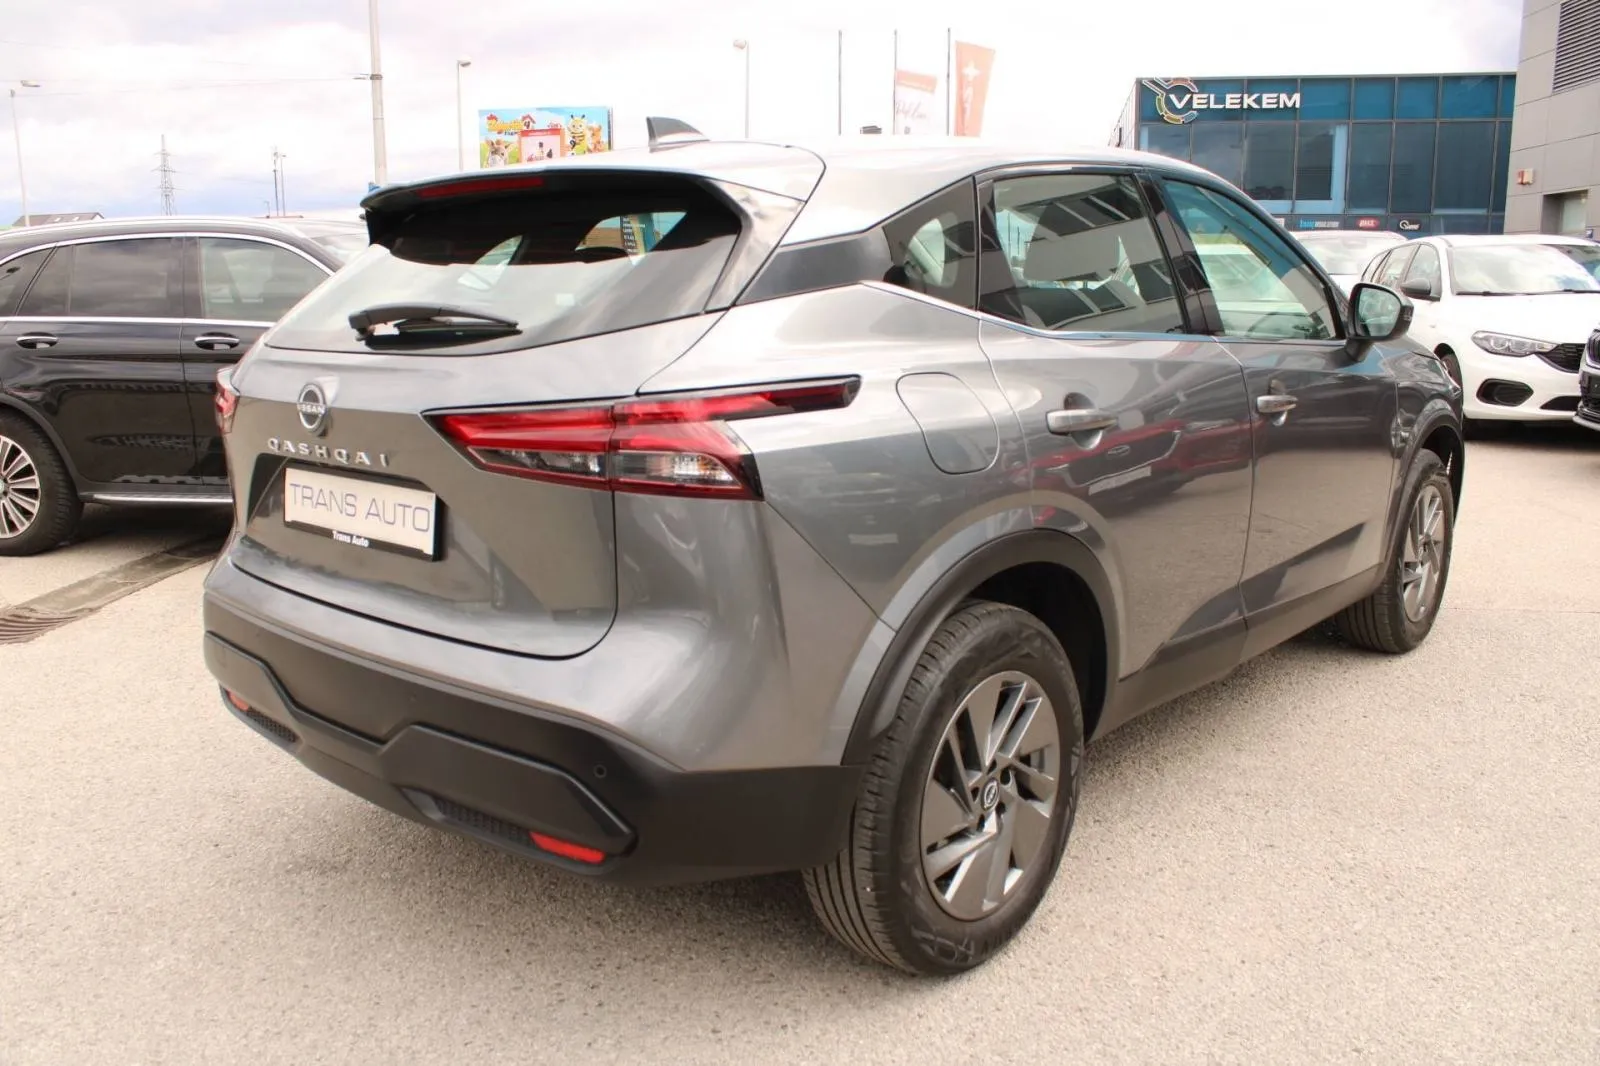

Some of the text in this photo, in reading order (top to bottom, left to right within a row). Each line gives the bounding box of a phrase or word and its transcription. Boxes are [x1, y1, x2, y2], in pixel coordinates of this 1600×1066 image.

[1168, 92, 1301, 109] VELEKEM
[267, 437, 387, 468] QASHQAI
[290, 482, 431, 533] TRANS AUTO
[332, 530, 370, 549] Trans Auto
